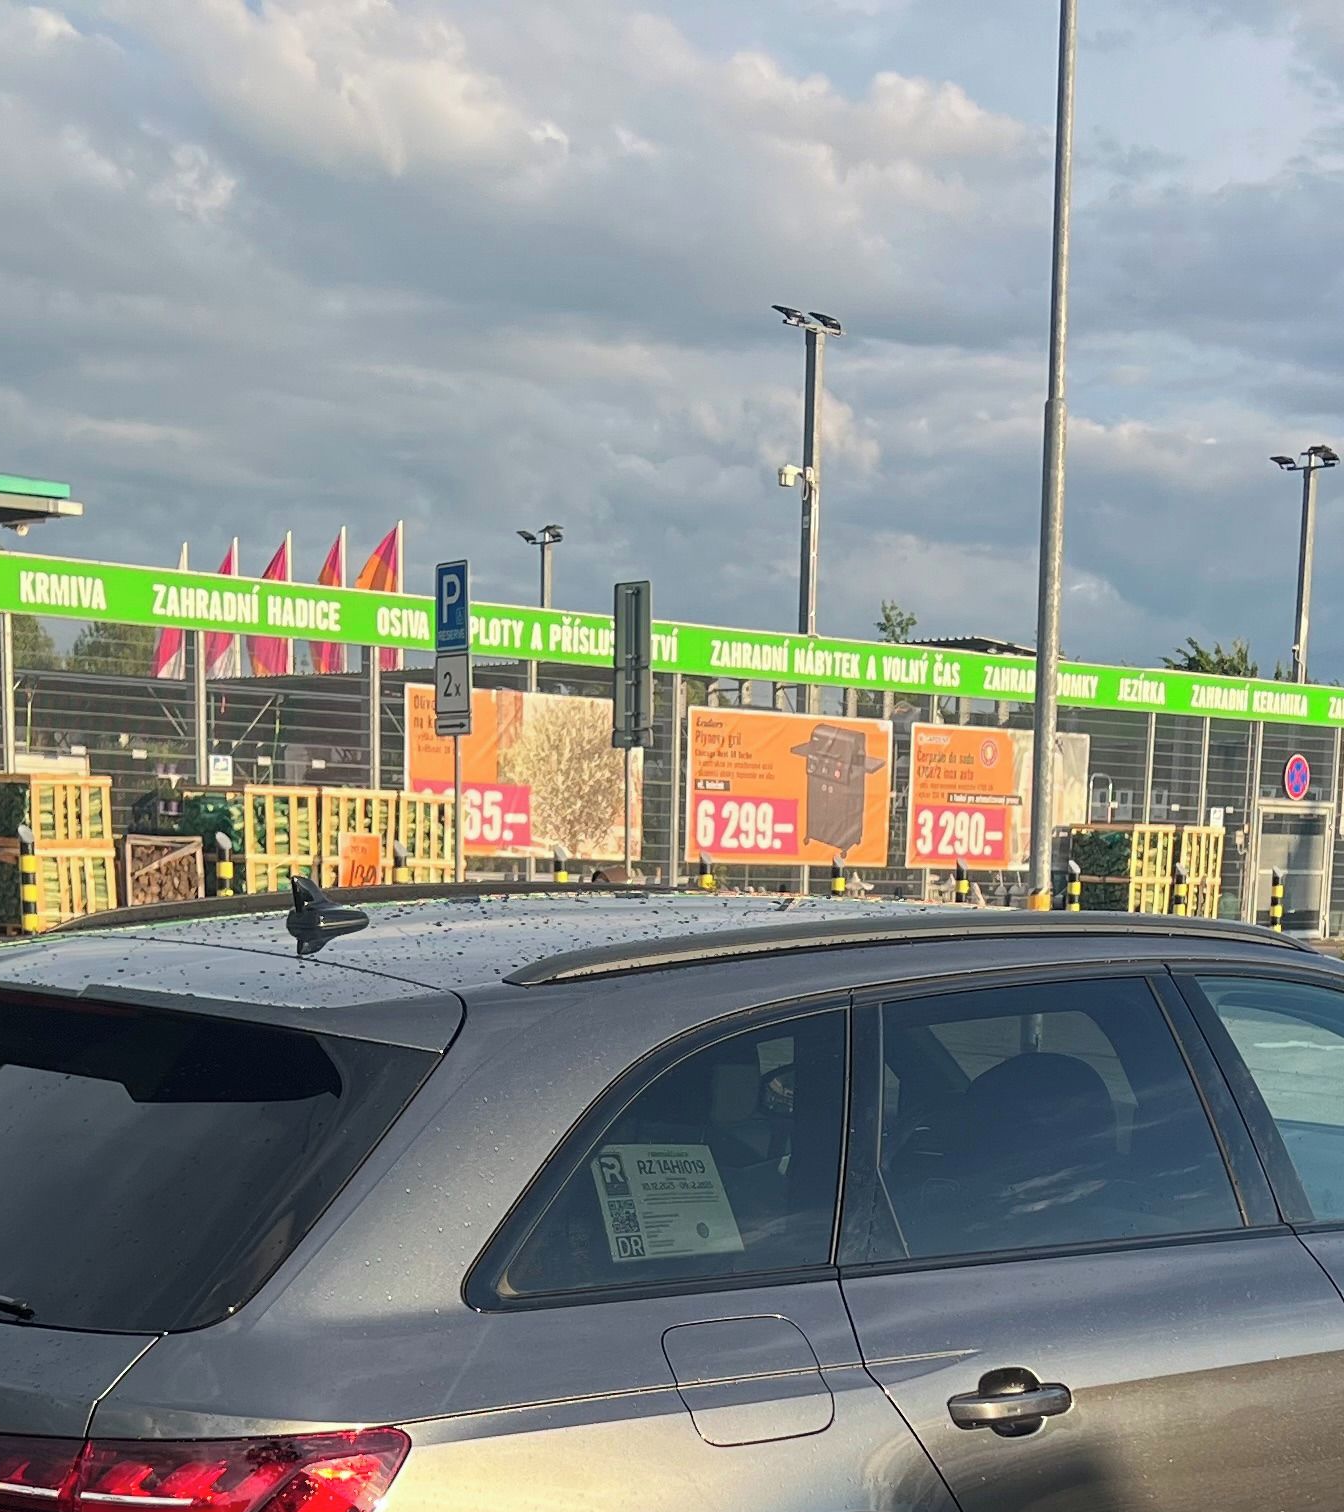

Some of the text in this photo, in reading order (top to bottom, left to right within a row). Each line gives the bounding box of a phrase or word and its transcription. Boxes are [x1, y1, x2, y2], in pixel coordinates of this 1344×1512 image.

[19, 570, 107, 610] KRMIVA
[152, 584, 341, 632] ZAHRADNÍ HADICE
[442, 573, 461, 624] P
[376, 606, 430, 640] OSIVA
[469, 615, 679, 663] PLOTY A PŘÍSLUTVÍ
[710, 639, 960, 687] ZAHRADNÍ NÁBYTEK A VOLNÝ ČAS
[983, 665, 1036, 693] ZAHRAD
[1117, 674, 1165, 706] JEZÍRKA
[1192, 683, 1308, 718] ZAHRADNÍ KERAMIKA
[697, 799, 716, 848] 6
[917, 809, 934, 855] 3
[637, 1160, 656, 1175] RZ
[617, 1236, 645, 1257] DR
